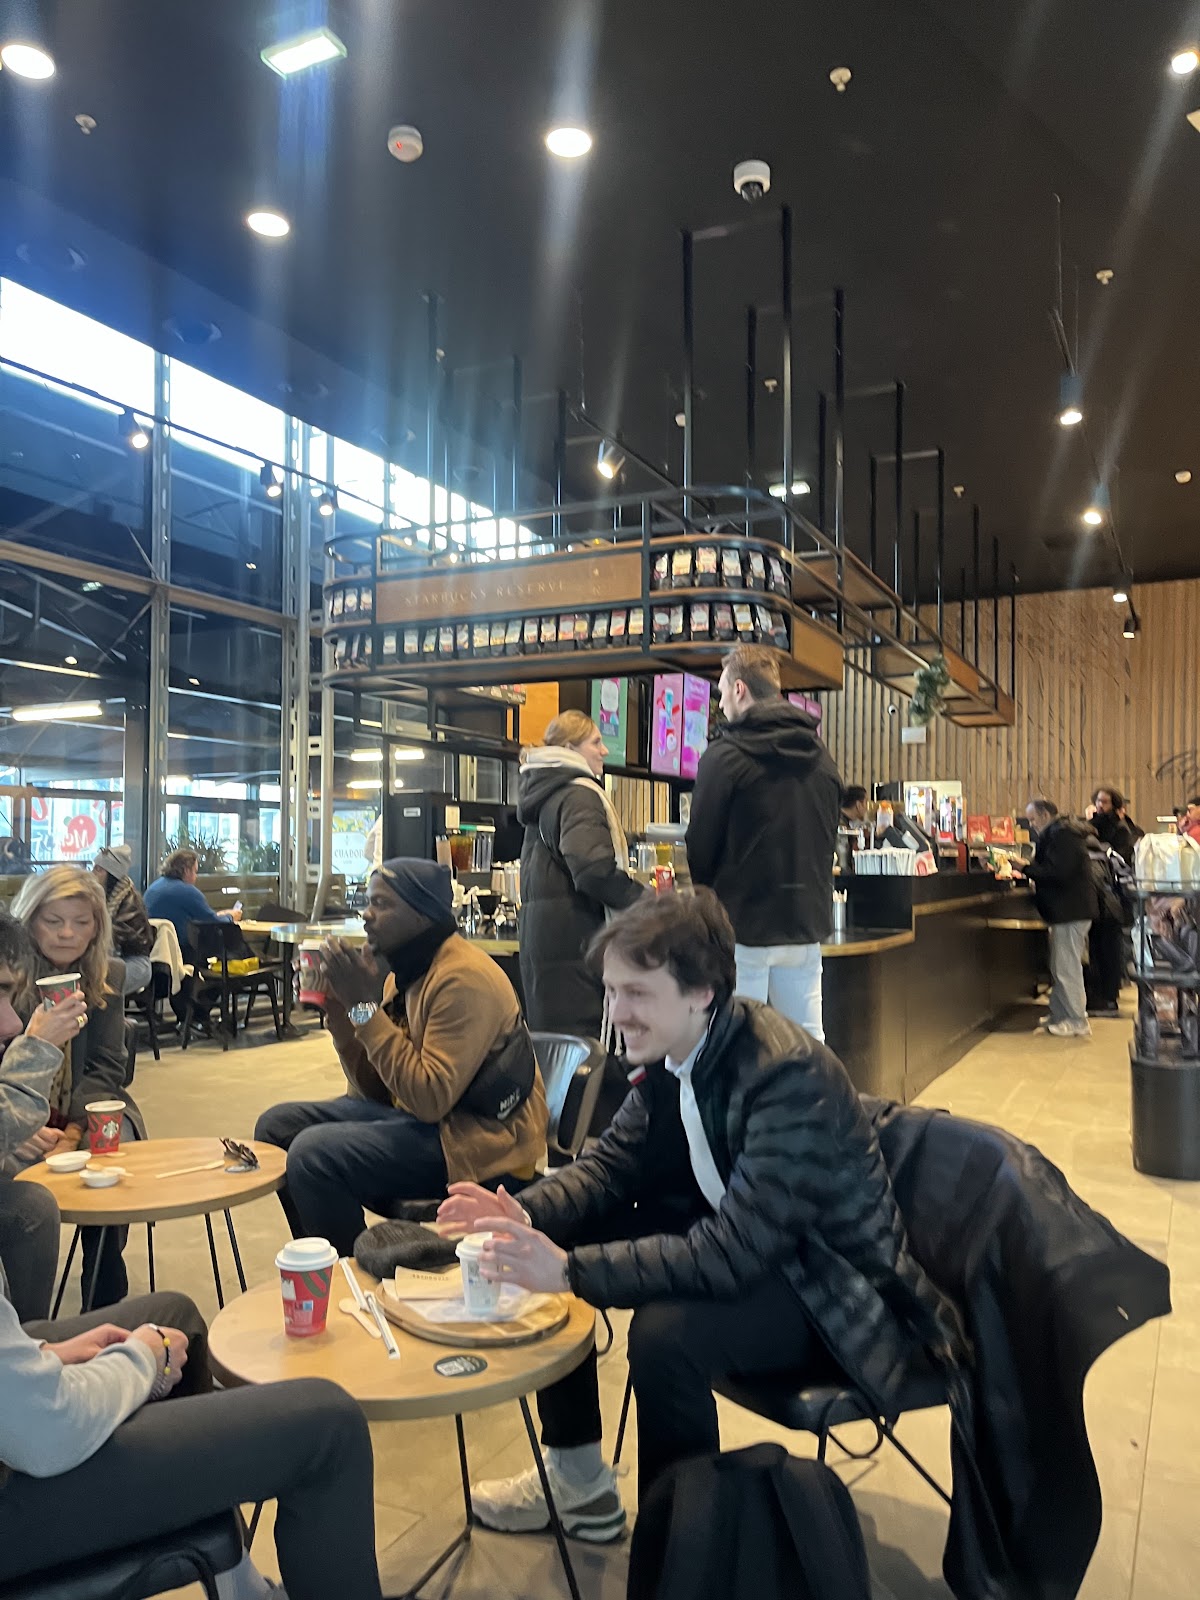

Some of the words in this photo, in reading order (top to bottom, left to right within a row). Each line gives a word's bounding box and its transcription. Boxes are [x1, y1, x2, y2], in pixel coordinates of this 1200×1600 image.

[404, 587, 487, 607] STARBUCKS
[496, 580, 564, 597] RESERVE
[500, 1088, 520, 1112] NIKE
